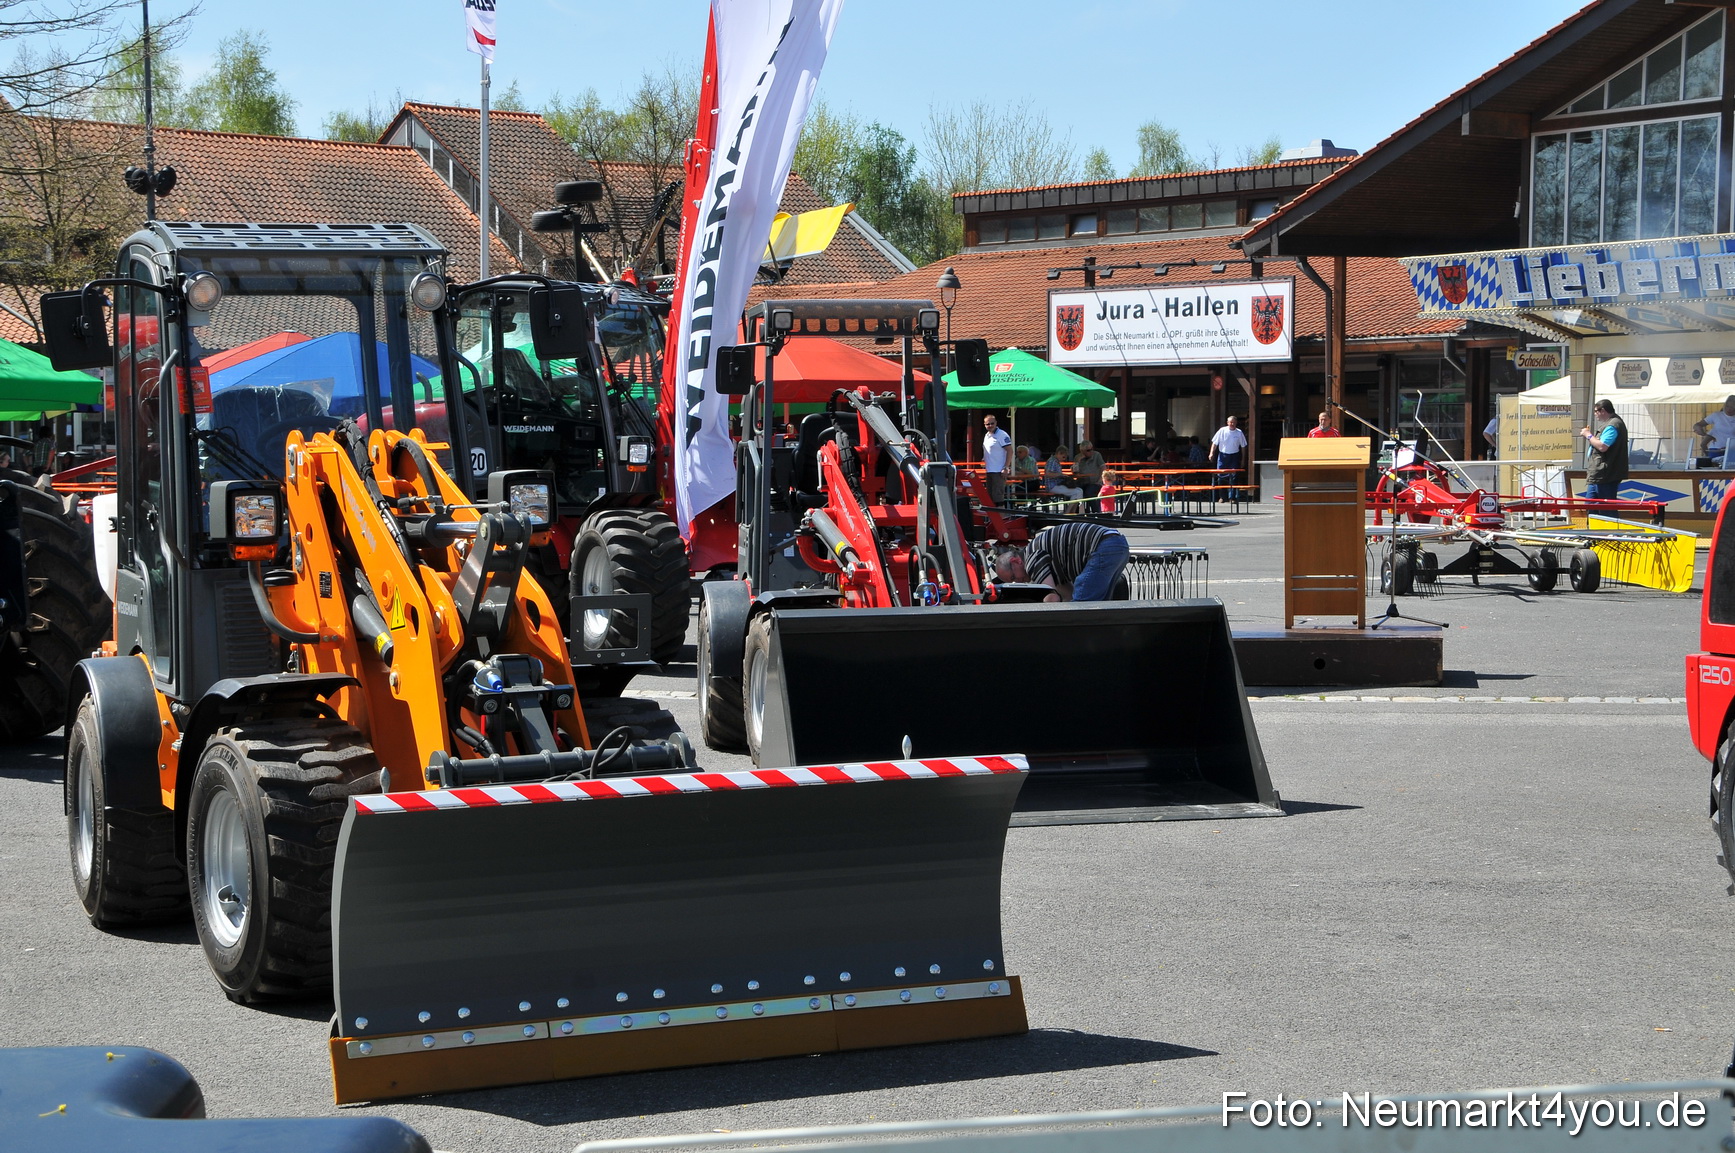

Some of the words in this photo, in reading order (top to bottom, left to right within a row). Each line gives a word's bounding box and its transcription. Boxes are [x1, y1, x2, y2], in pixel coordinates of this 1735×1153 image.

[675, 216, 687, 290] WEIDEMANN
[1096, 300, 1145, 321] Jura
[1165, 296, 1239, 318] Hallen
[1093, 333, 1103, 341] Die
[1105, 332, 1122, 341] Stadt
[1123, 331, 1154, 340] Neumarkt
[1169, 329, 1184, 338] OPf.
[1185, 328, 1204, 340] grüßt
[1205, 328, 1218, 338] ihre
[1220, 327, 1239, 337] Gäste
[1085, 344, 1098, 352] und
[1099, 343, 1126, 351] wünscht
[1127, 342, 1145, 350] Ihnen
[1147, 341, 1165, 350] einen
[1166, 340, 1208, 351] angenehmen
[1210, 338, 1249, 348] Aufenthalt!
[503, 425, 554, 433] WEIDEMANN
[471, 453, 485, 471] 20
[1699, 664, 1732, 686] 1250
